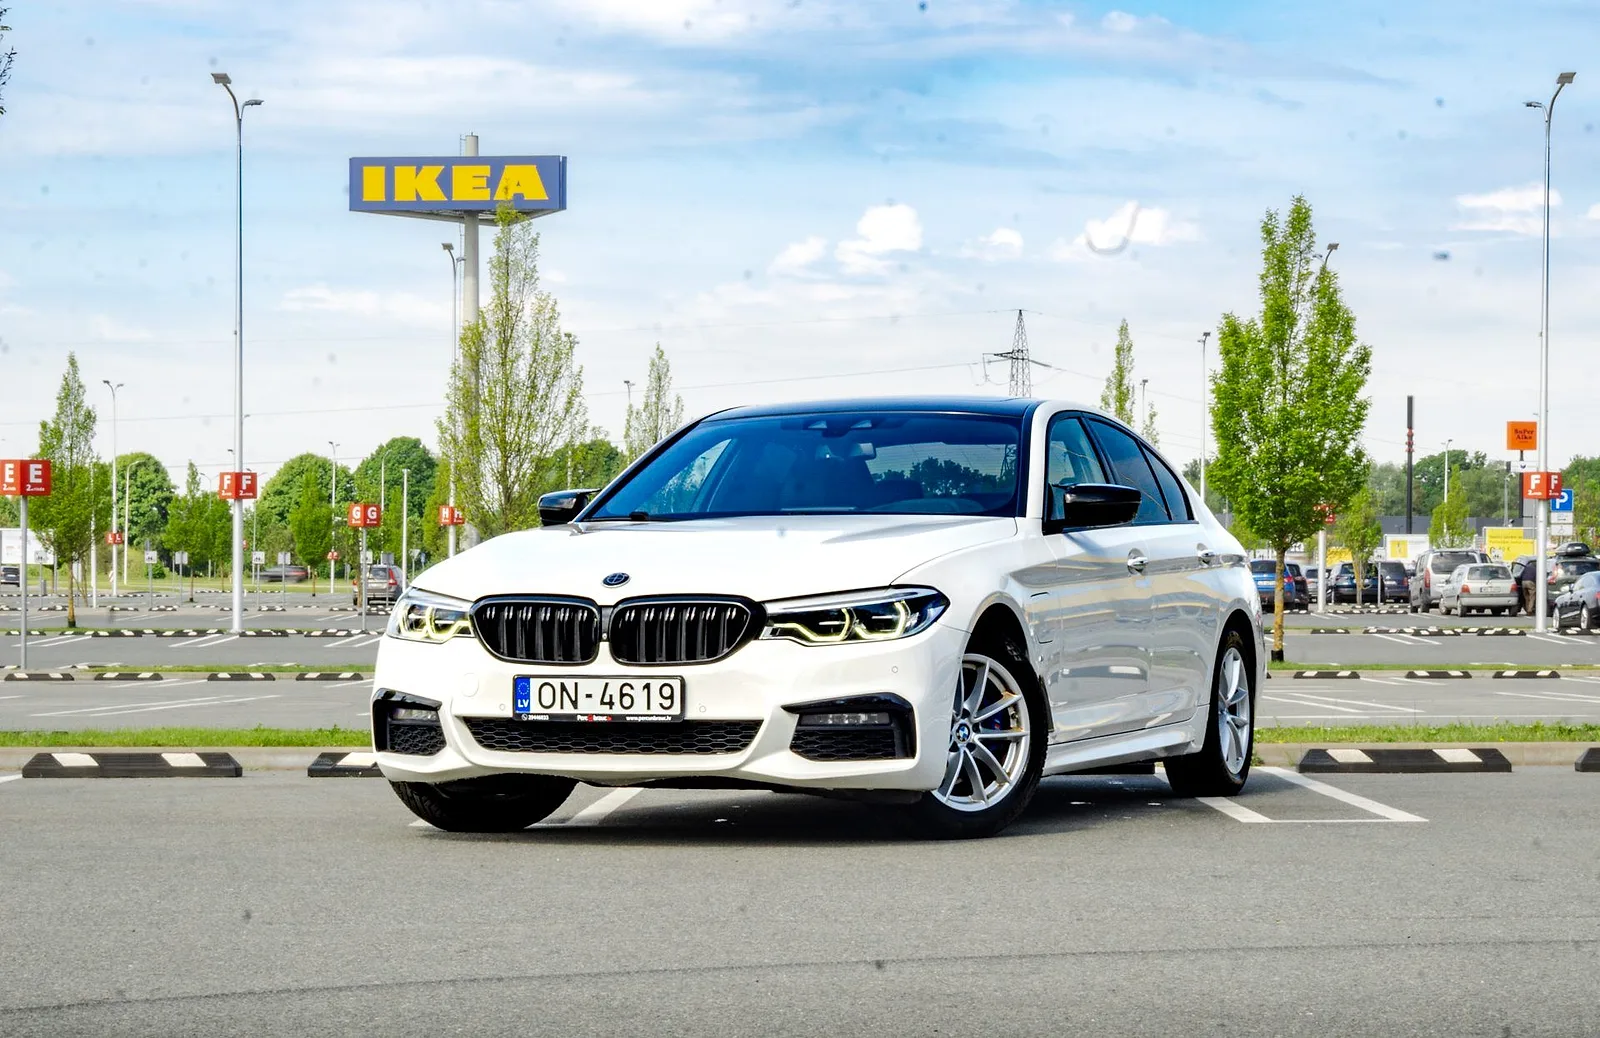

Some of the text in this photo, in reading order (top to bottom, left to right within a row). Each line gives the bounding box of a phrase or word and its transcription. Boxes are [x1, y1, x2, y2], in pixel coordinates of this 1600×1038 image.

[363, 165, 549, 202] IKEA
[4, 463, 15, 483] E
[29, 463, 43, 484] E
[223, 474, 232, 490] F
[241, 474, 252, 490] F
[1530, 474, 1541, 490] F
[1550, 474, 1559, 490] F
[1555, 492, 1569, 510] P
[352, 506, 361, 520] G
[367, 507, 378, 520] G
[442, 508, 449, 519] H
[517, 699, 530, 708] LV
[538, 681, 675, 711] ON-4619
